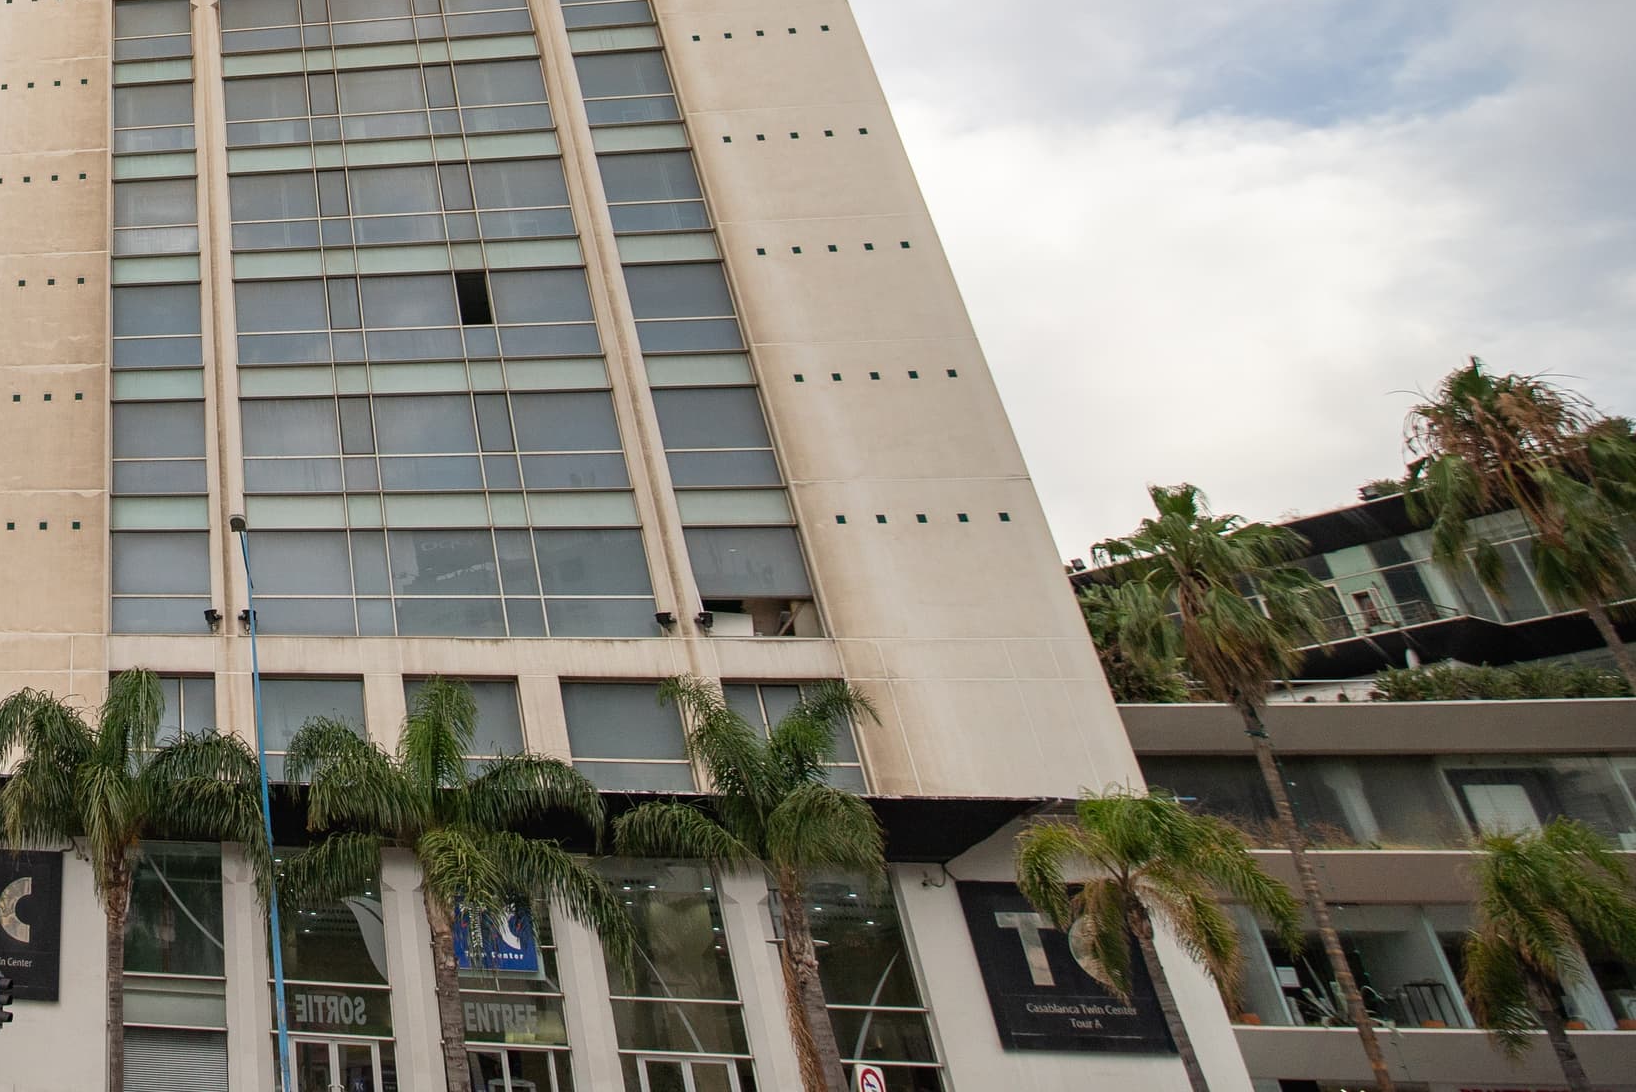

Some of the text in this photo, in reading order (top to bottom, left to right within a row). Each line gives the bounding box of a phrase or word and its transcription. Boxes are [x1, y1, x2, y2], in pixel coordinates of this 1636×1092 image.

[7, 957, 33, 968] Center
[1025, 1002, 1137, 1016] Casablanca Twin Center
[1069, 1018, 1093, 1029] Tour
